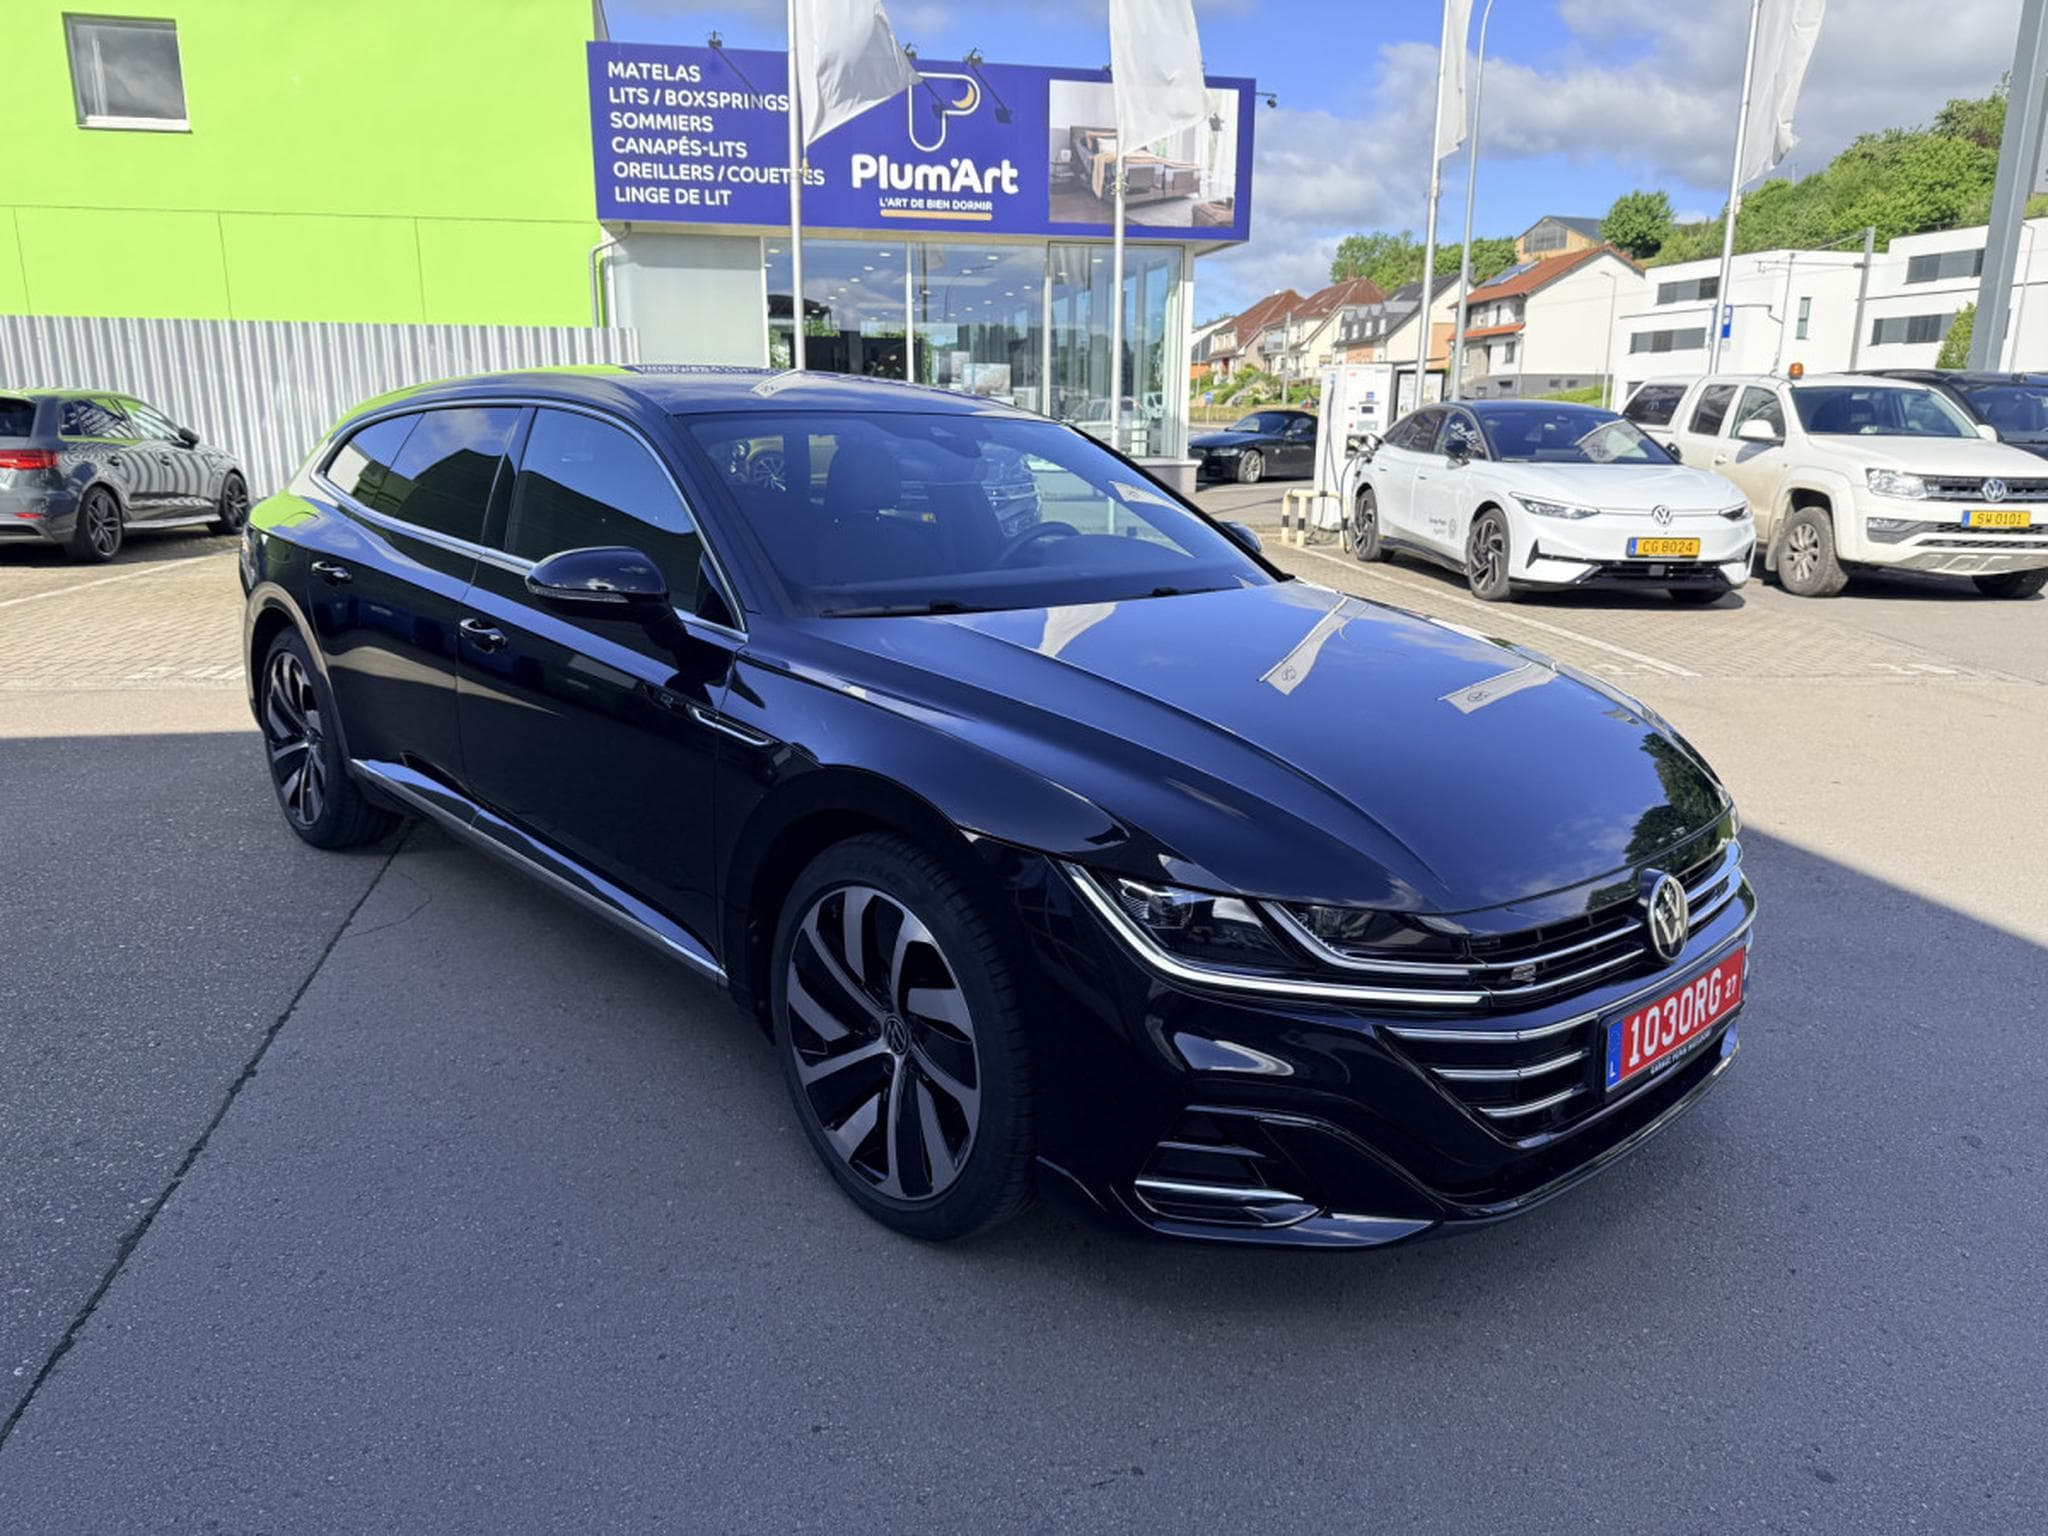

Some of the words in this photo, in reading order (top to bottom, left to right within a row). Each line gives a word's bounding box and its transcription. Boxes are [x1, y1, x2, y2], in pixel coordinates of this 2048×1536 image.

[608, 61, 701, 82] MATELAS
[609, 86, 649, 105] LITS
[665, 89, 790, 112] BOXSPRINGS
[610, 112, 714, 132] SOMMIERS
[611, 136, 748, 158] CANAPÉS-LITS
[613, 162, 715, 182] OREILLERS
[615, 186, 670, 205] LINGE
[675, 188, 701, 205] DE
[705, 189, 732, 206] LIT
[879, 197, 909, 208] L'ART
[911, 199, 925, 209] DE
[927, 199, 950, 210] BIEN
[952, 200, 993, 211] DORMIR
[1642, 540, 1658, 552] CG
[1661, 540, 1694, 552] 8024
[1629, 967, 1722, 1068] 1030RG
[1725, 974, 1737, 999] 27
